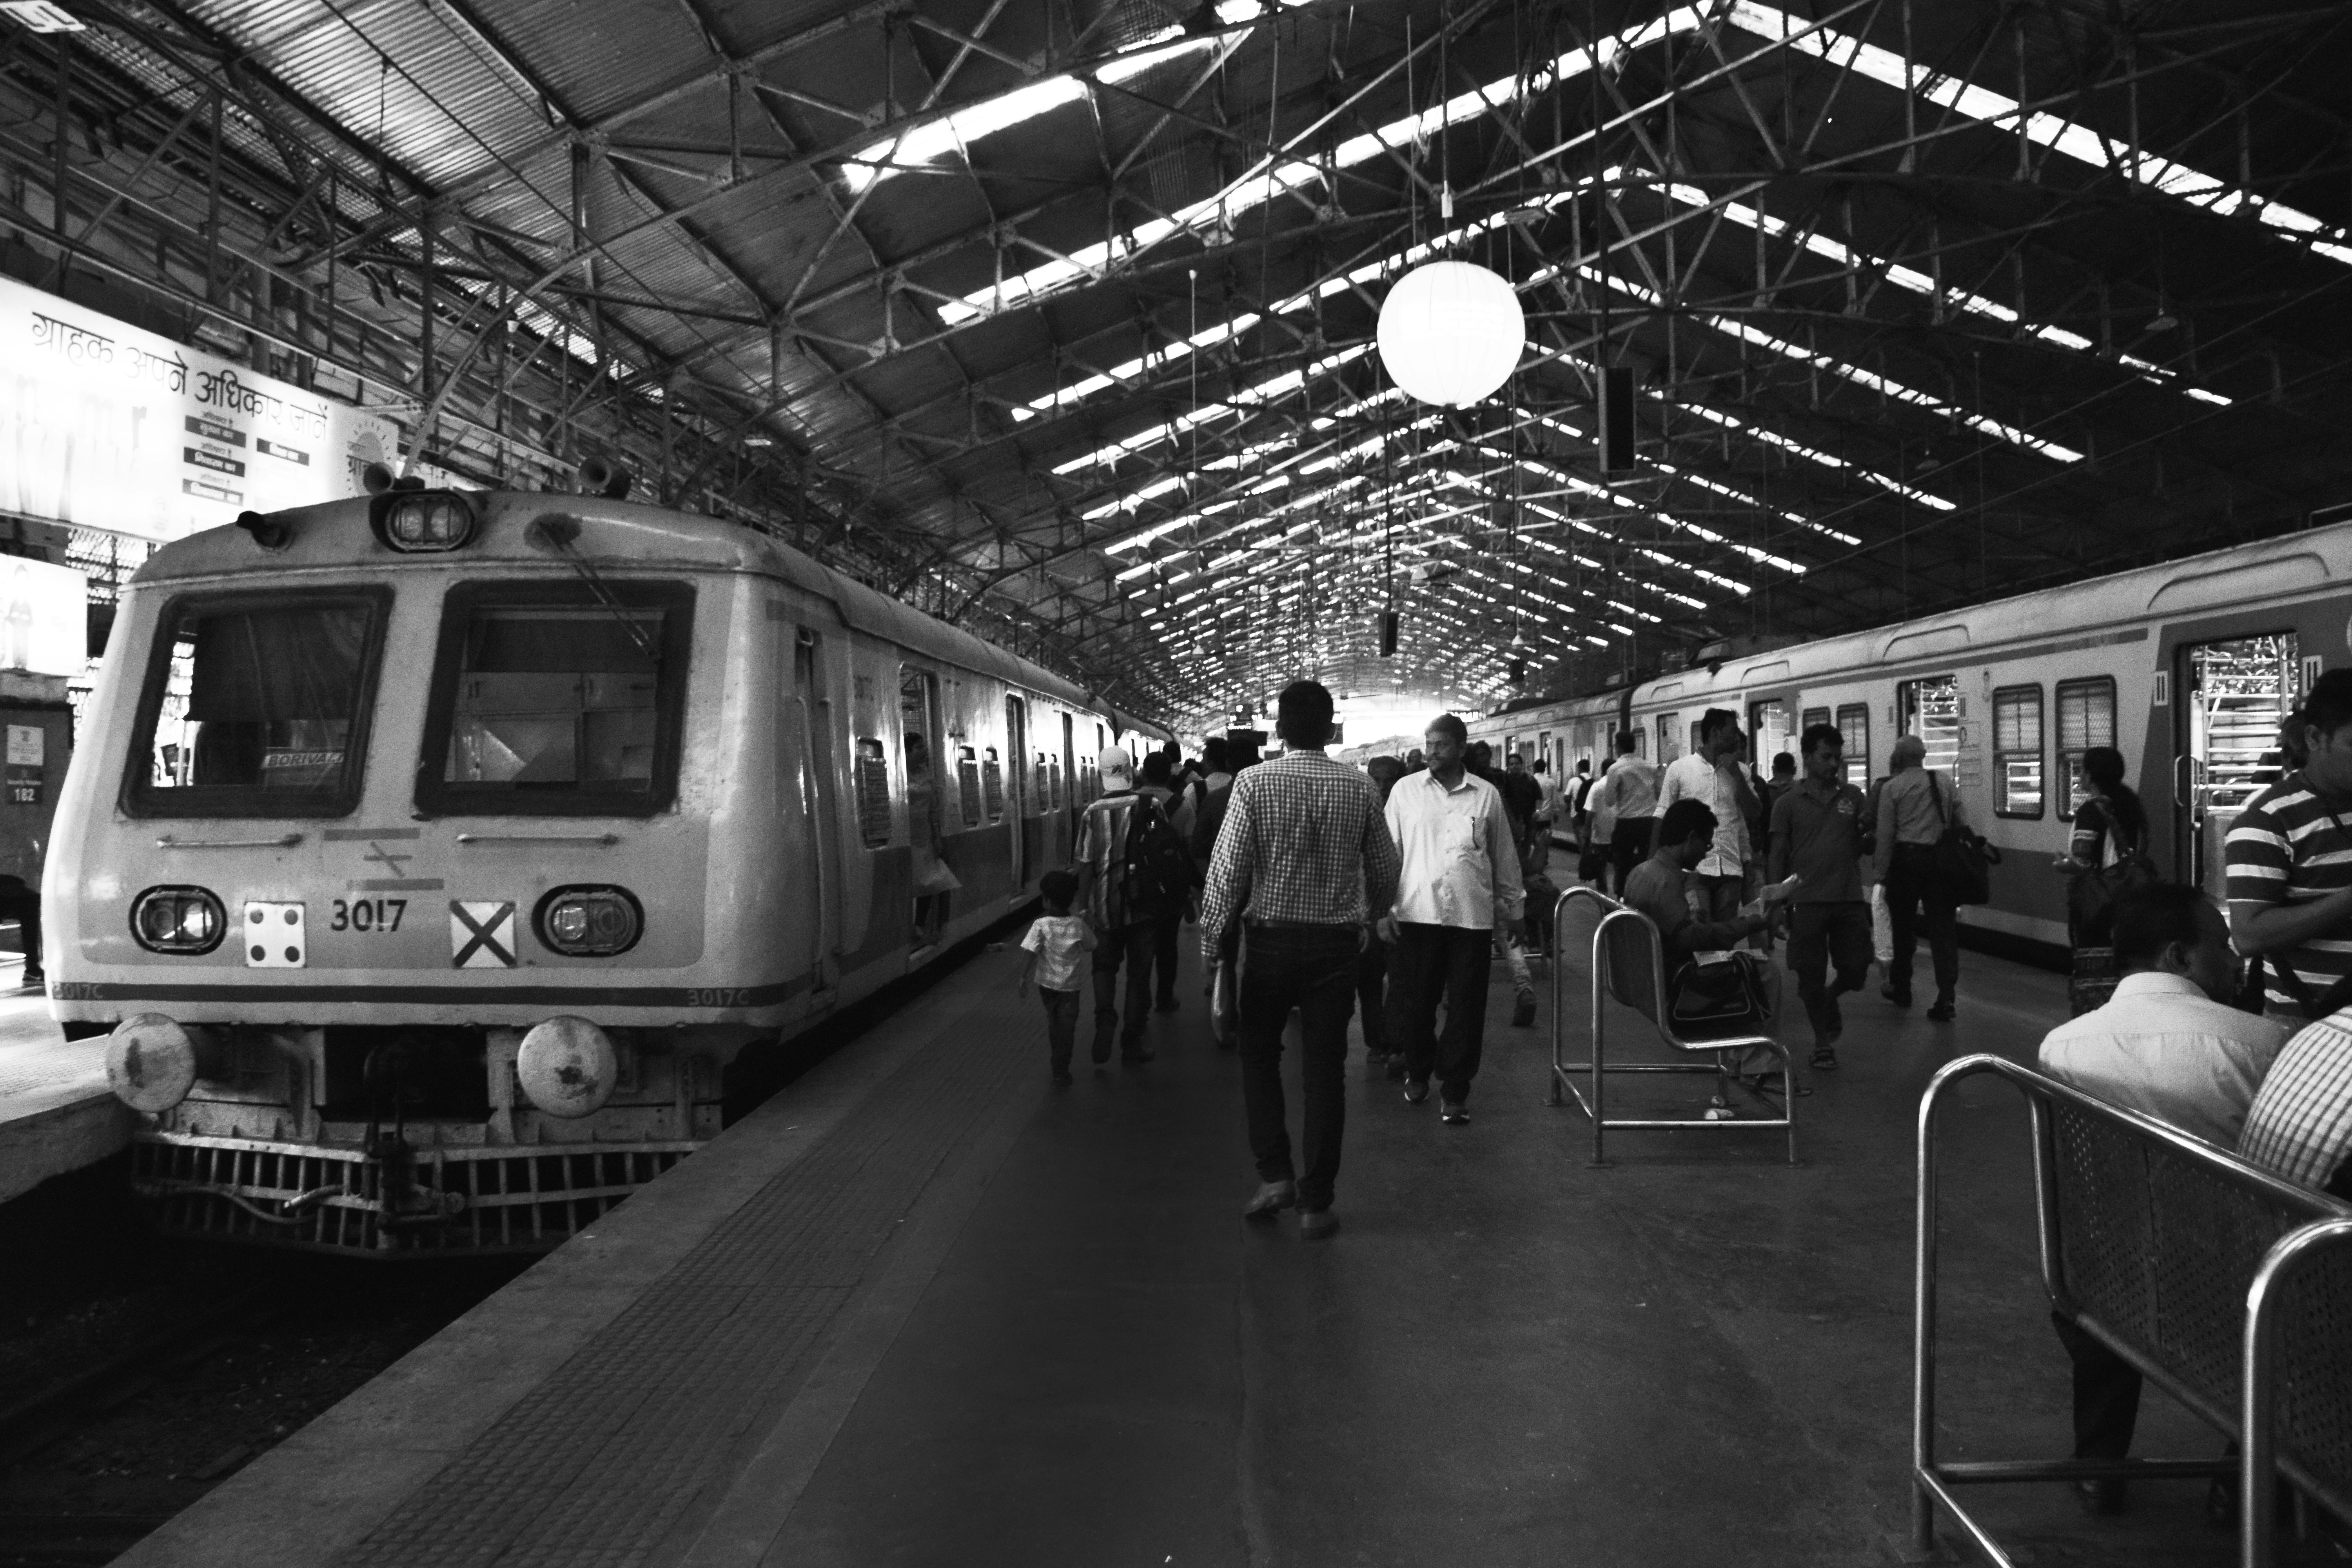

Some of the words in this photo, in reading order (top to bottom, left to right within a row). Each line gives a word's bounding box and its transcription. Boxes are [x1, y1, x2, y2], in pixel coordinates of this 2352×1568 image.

[32, 312, 114, 367] ग्राहक
[125, 347, 188, 394] अपने
[195, 370, 283, 425] अधिकार
[330, 899, 408, 932] 3017
[688, 989, 748, 1006] 3017C
